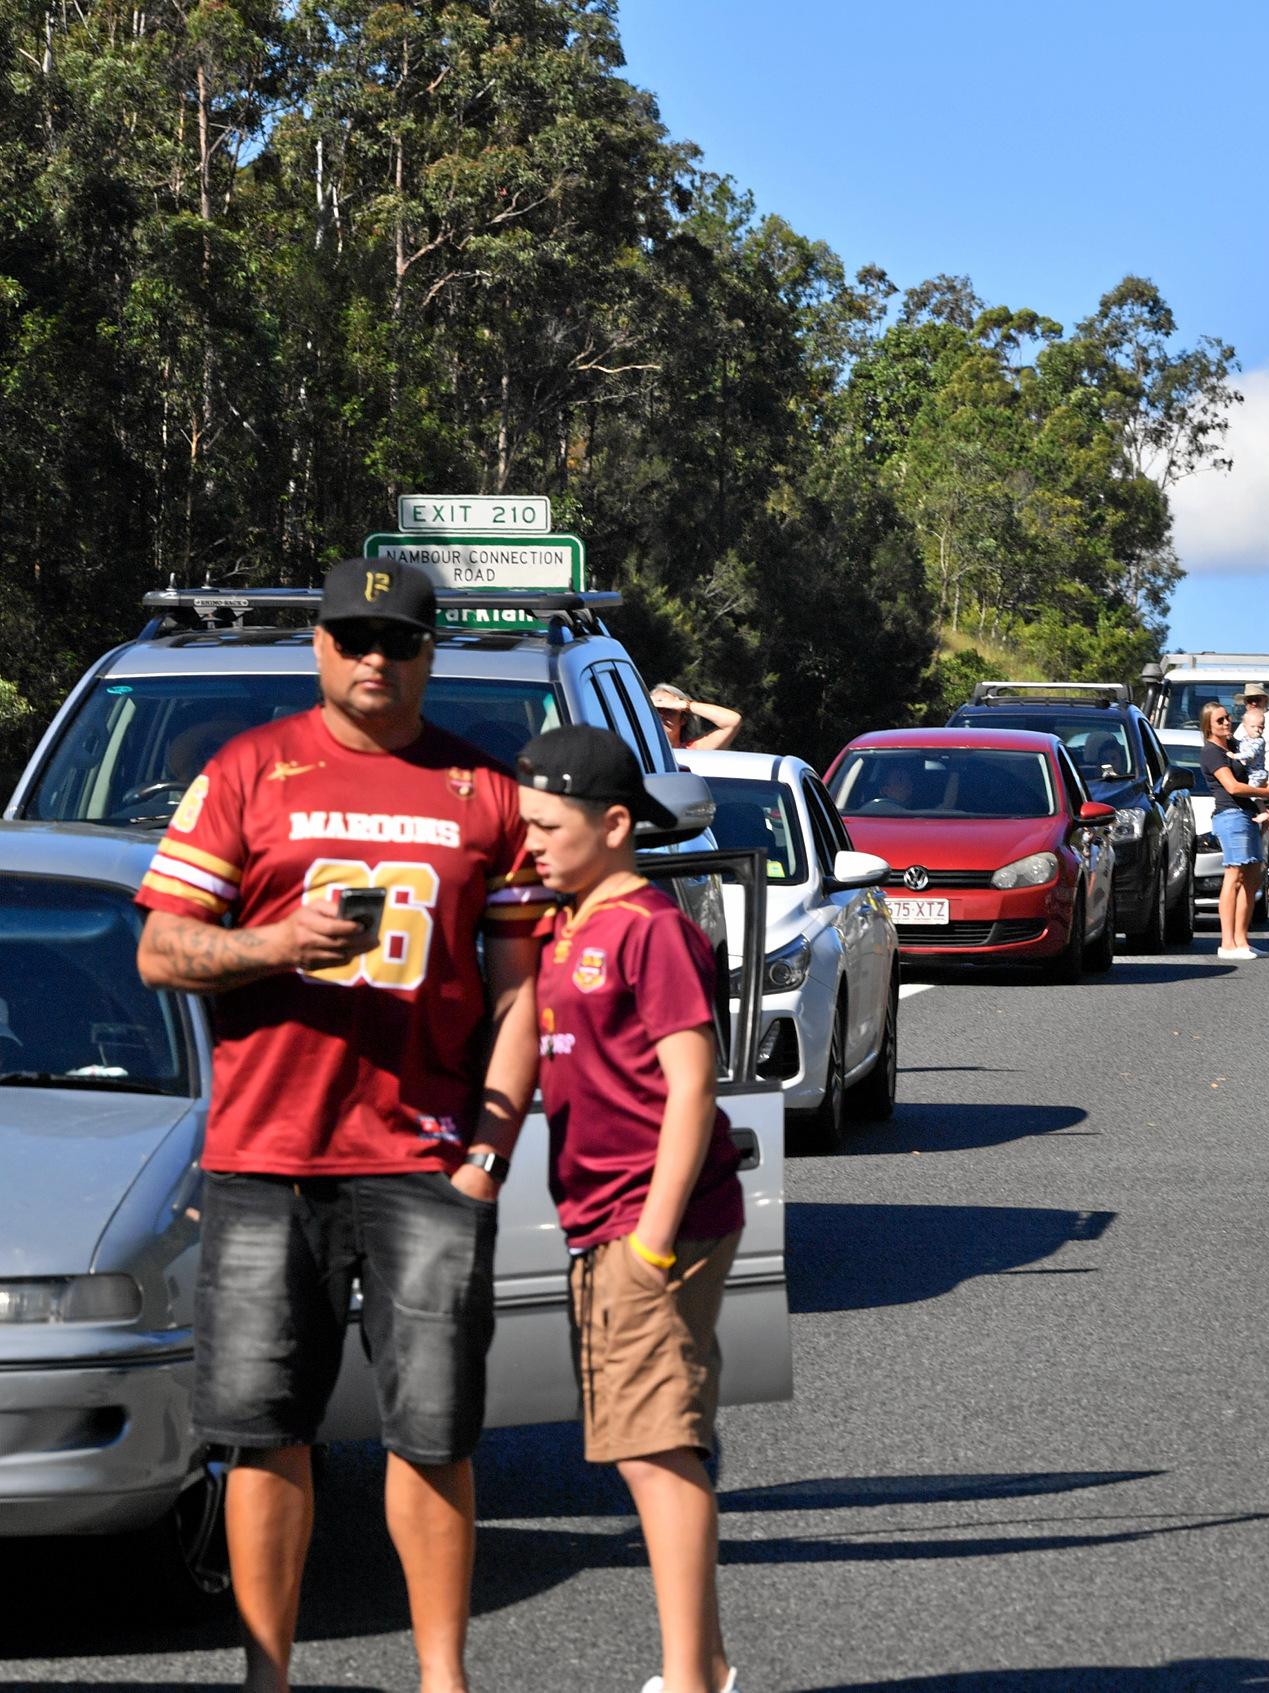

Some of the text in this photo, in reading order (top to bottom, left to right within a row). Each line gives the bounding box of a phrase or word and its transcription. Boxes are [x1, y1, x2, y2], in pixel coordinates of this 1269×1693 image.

[413, 505, 536, 523] EXIT 210
[386, 550, 563, 564] NAMBOUR CONNECTION
[454, 568, 495, 581] ROAD
[289, 811, 461, 849] MAROONS
[916, 902, 946, 917] XTZ
